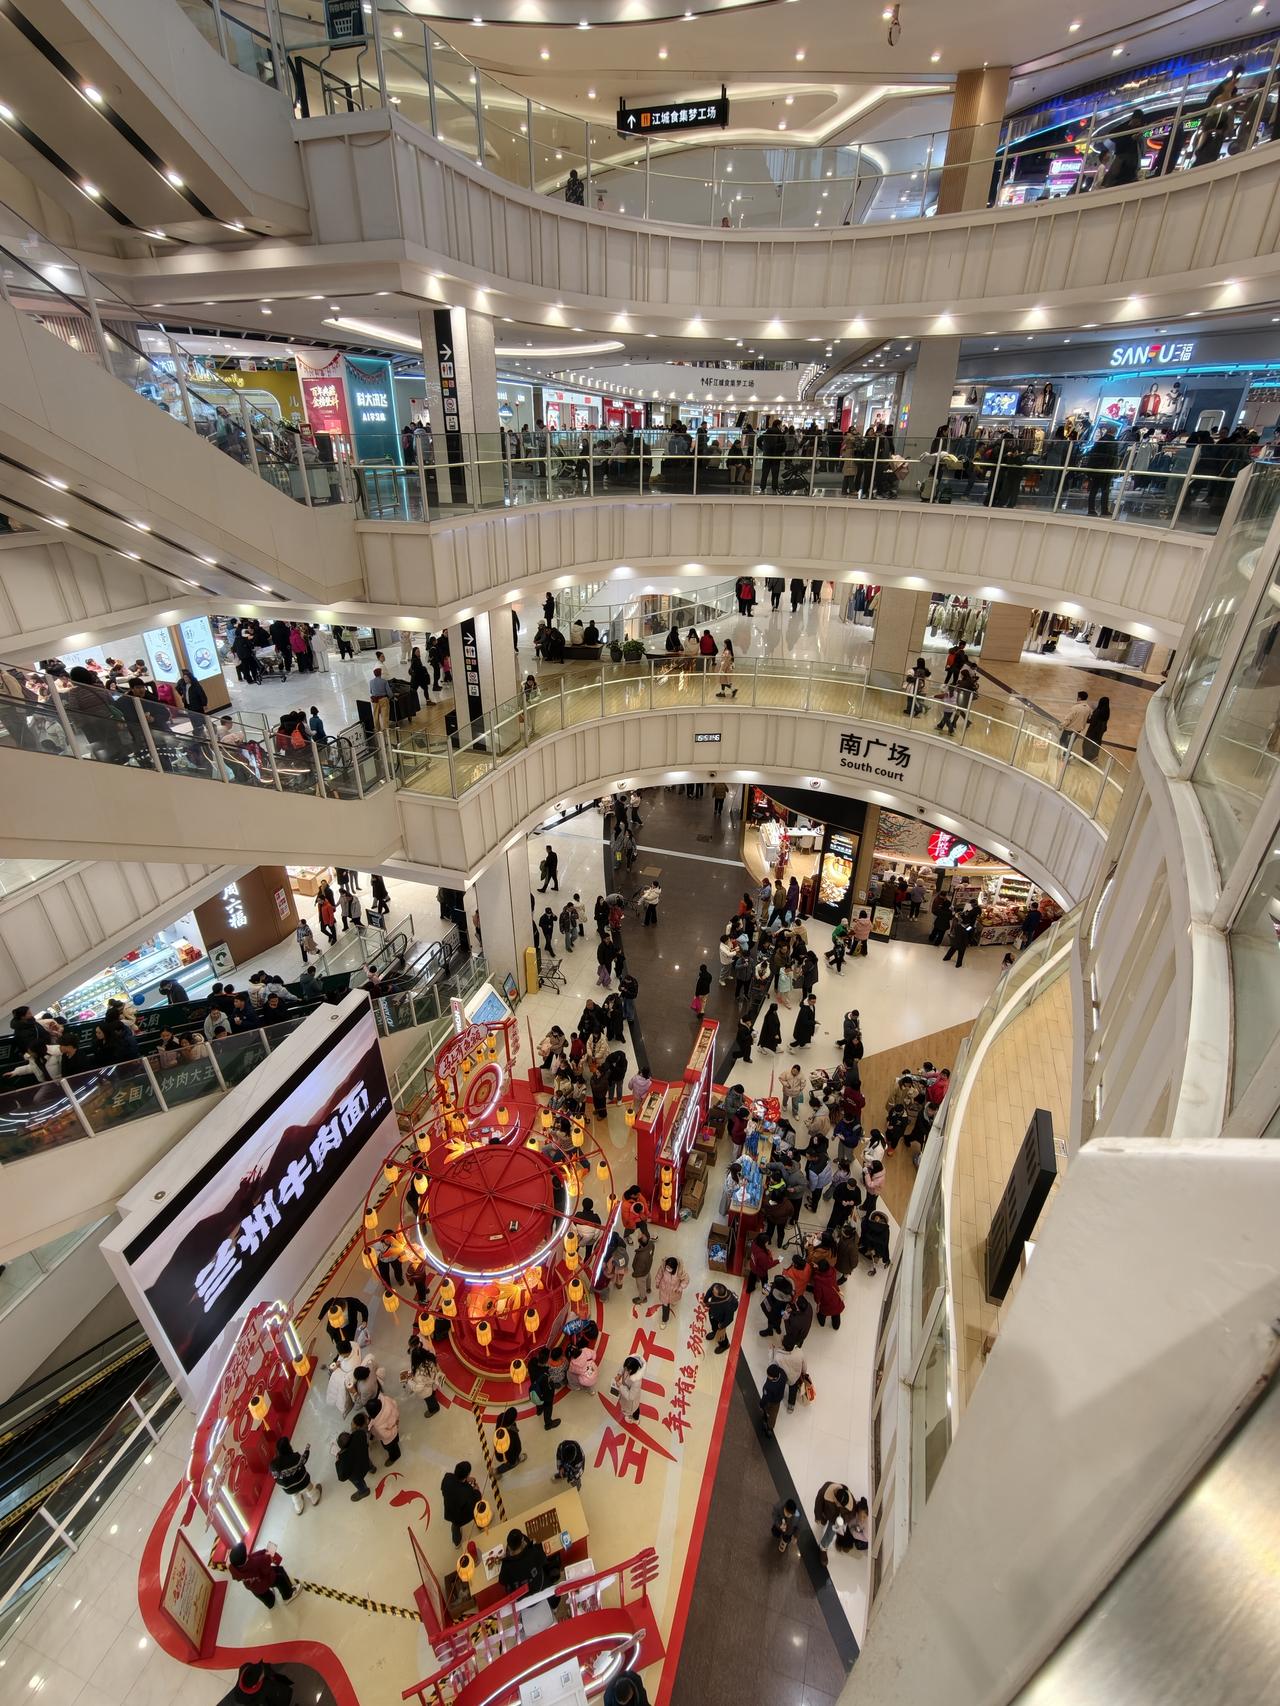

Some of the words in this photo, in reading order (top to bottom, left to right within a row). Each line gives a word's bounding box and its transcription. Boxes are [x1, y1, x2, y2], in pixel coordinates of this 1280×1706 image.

[652, 106, 717, 125] 江城食集梦工场
[1172, 343, 1194, 362] 三福
[356, 392, 388, 407] 科大讯飞
[839, 733, 911, 768] 南广场
[840, 757, 873, 773] South
[874, 767, 904, 782] court
[195, 1080, 369, 1313] 兰州牛肉面
